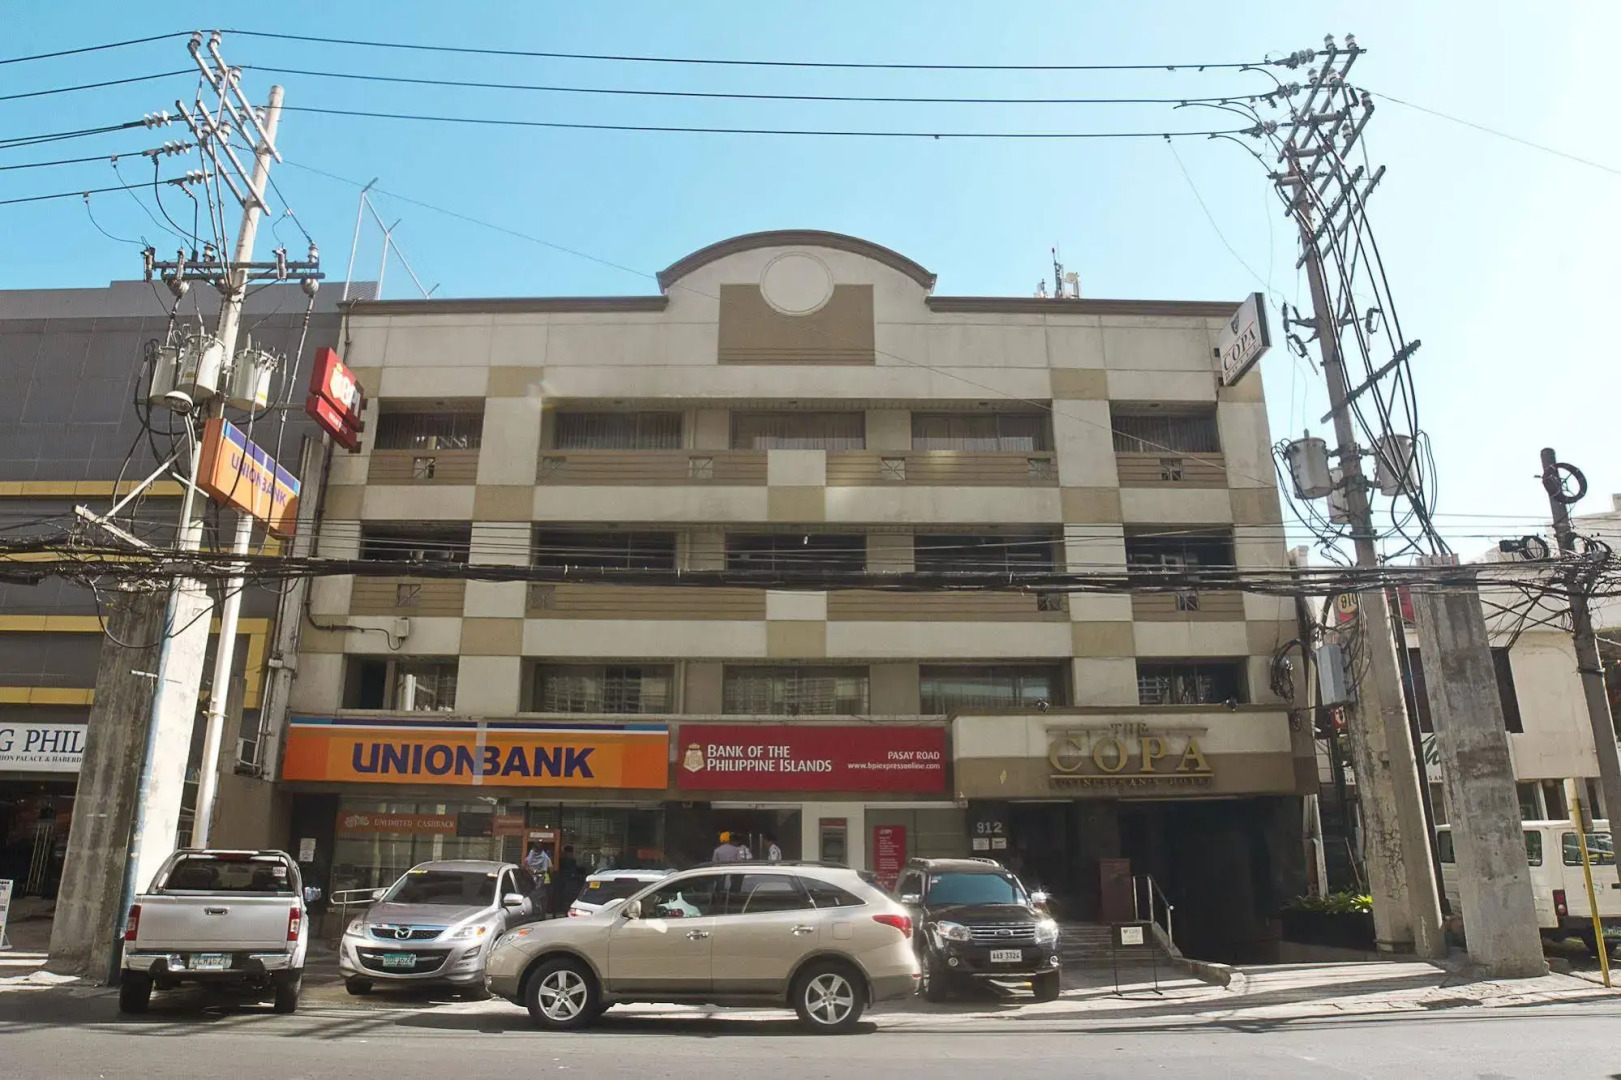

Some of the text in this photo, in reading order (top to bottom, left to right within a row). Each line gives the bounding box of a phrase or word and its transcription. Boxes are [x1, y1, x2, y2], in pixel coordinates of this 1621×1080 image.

[231, 453, 286, 507] UNIONBANK
[22, 730, 84, 753] PHIL
[707, 744, 790, 758] BANK OF THE
[888, 751, 940, 760] PASAY ROAD
[1049, 735, 1212, 773] COPA
[352, 742, 596, 779] UNIONBANK
[707, 759, 832, 772] PHILIPPINE ISLANDS
[848, 761, 941, 770] www.bpiexpressonline.com
[374, 818, 455, 828] UNLIMITED CASHBACK
[977, 821, 1002, 833] 912
